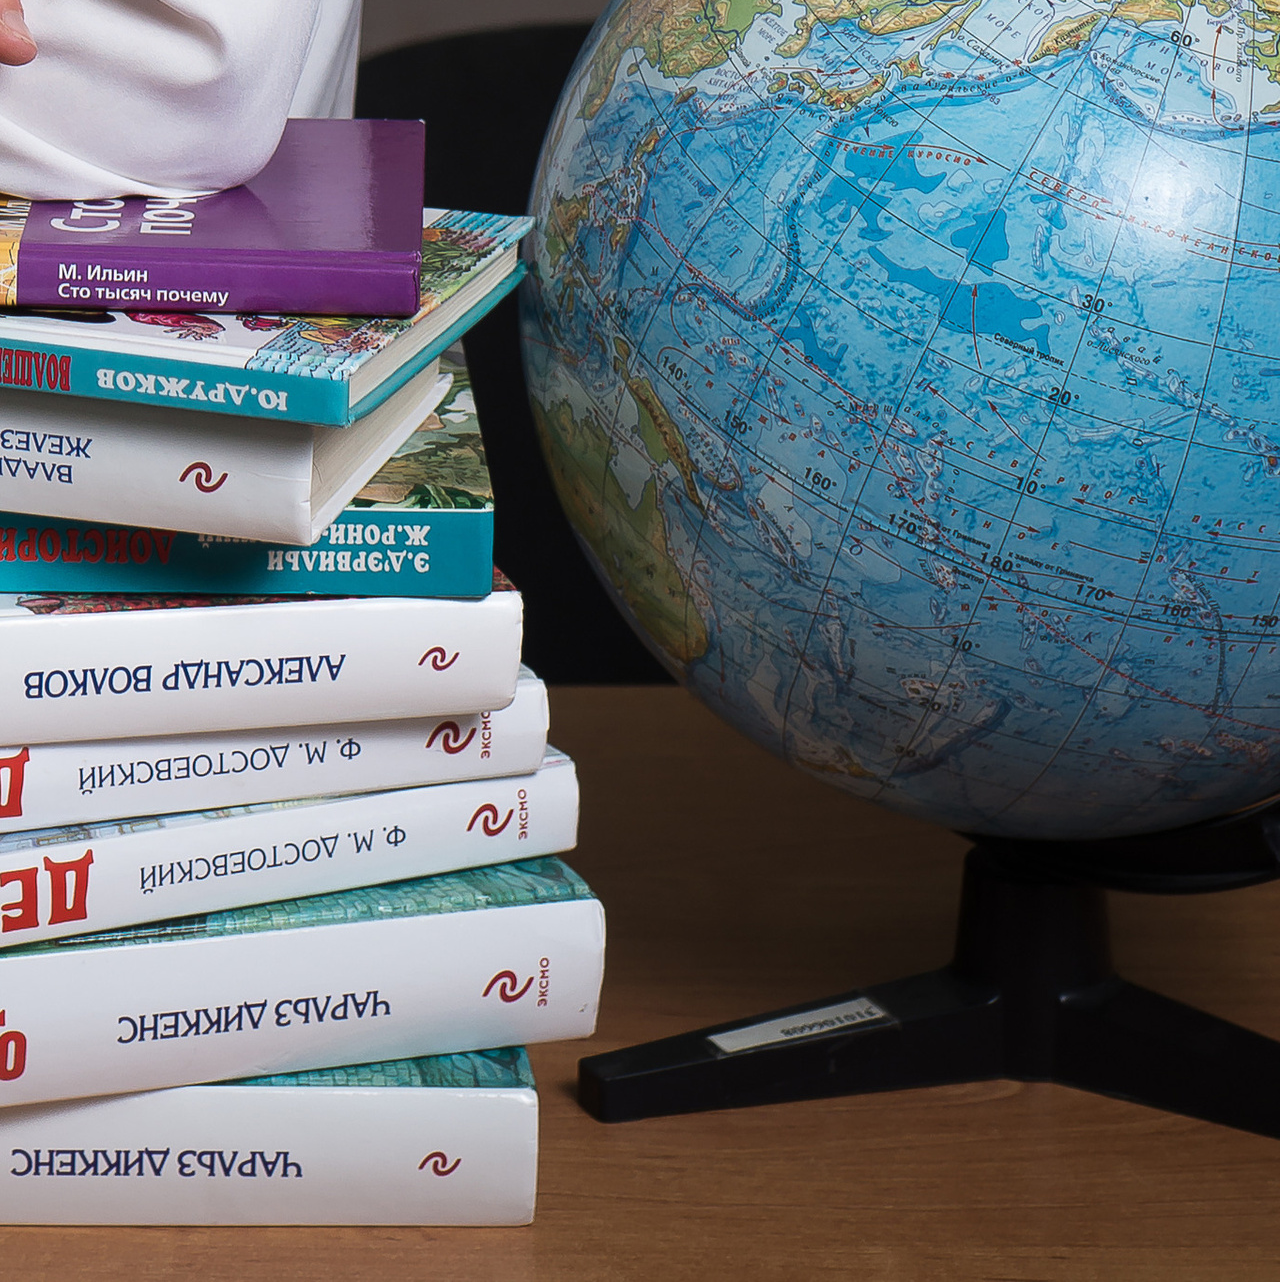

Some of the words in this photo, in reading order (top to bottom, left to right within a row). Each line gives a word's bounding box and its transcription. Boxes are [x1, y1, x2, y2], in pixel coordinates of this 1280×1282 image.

[984, 13, 1022, 39] МОРЕ
[1170, 29, 1200, 47] 60°
[1123, 29, 1235, 75] БЕРИНГОВО
[1099, 52, 1161, 83] Командорские
[1144, 60, 1195, 84] МОРЕ
[835, 141, 895, 159] ТЕЧЕНИЕ
[907, 149, 972, 167] КУРОСИО
[57, 263, 82, 281] М.
[86, 264, 148, 283] Ильин
[57, 283, 91, 300] Сто
[95, 287, 151, 302] тысяч
[156, 289, 229, 307] почему
[1081, 293, 1113, 313] 30°
[993, 332, 1035, 355] Северный
[1036, 348, 1065, 367] тропик
[662, 355, 688, 382] 140°
[95, 368, 288, 413] Ю.ДРУЖКОВ
[1048, 385, 1080, 406] 20°
[723, 410, 753, 435] 150°
[804, 467, 837, 491] 160°
[1016, 477, 1046, 495] 10°
[888, 513, 923, 535] 170°
[979, 551, 1022, 573] 180°
[1014, 553, 1044, 570] западу
[1055, 565, 1094, 583] Гринвича
[960, 601, 1074, 623] ЮЖНОЕ
[1162, 603, 1198, 618] 160°
[23, 664, 153, 700] ВОЛКОВ
[162, 653, 347, 691] АЛЕКСАНДР
[298, 740, 328, 765] М.
[336, 736, 362, 761] Ф.
[78, 742, 290, 796] ДОСТОЕВСКИЙ
[516, 788, 529, 841] ЭКСМО
[346, 828, 375, 856] М.
[382, 824, 407, 848] Ф.
[138, 833, 341, 895] ДОСТОЕВСКИЙ
[536, 957, 550, 1008] ЭКСМО
[116, 998, 267, 1044] ДИККЕНС
[274, 990, 392, 1028] ЧАРЛЬЗ
[10, 1146, 171, 1178] ДИККЕНС
[177, 1149, 303, 1179] ЧАРЛЬЗ
